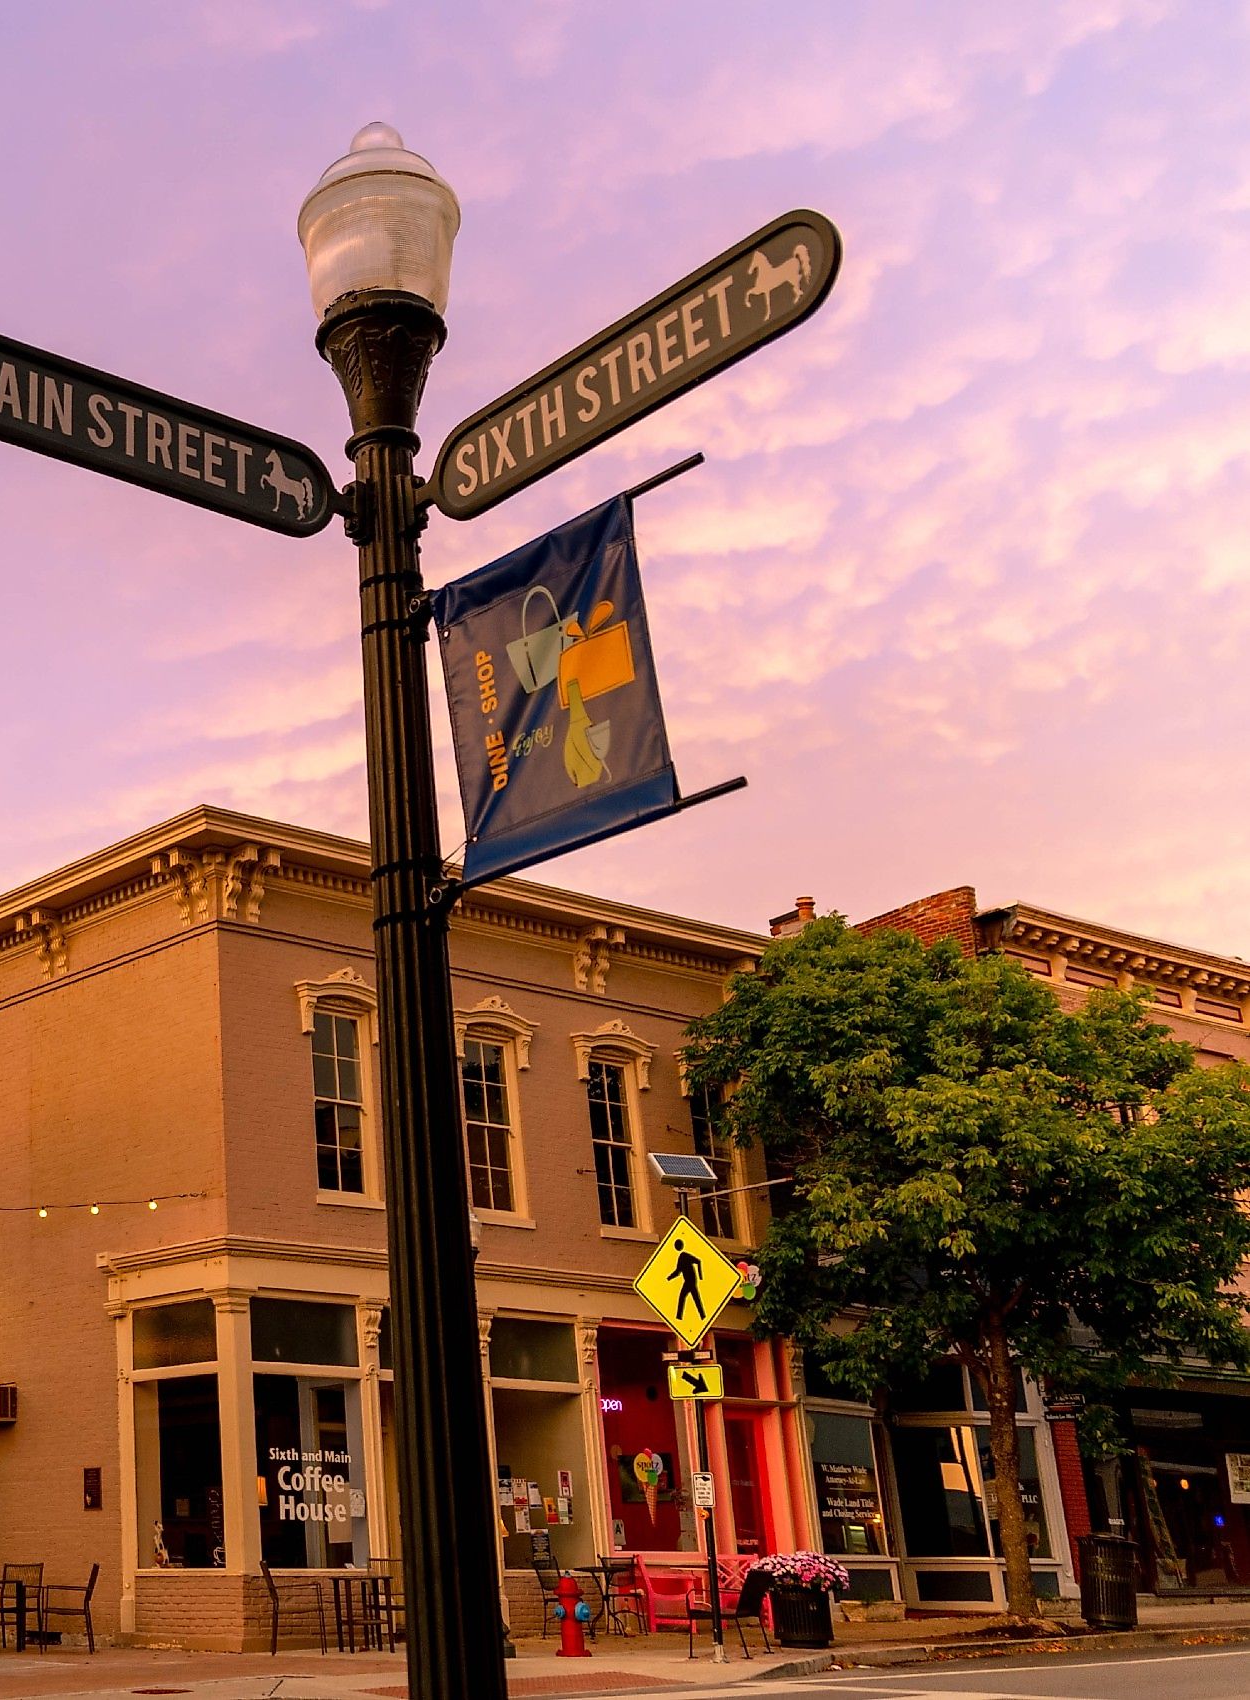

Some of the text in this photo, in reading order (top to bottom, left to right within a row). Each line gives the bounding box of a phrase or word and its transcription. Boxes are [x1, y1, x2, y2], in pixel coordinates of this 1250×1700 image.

[455, 275, 734, 497] SIXTH STREET
[87, 393, 253, 495] STREET
[474, 650, 508, 792] DINE SHOP
[269, 1447, 352, 1463] Sixth and Main
[277, 1465, 345, 1493] Coffee
[279, 1495, 347, 1522] House
[822, 1508, 833, 1518] and
[834, 1508, 855, 1520] Closing
[826, 1497, 874, 1508] Wade Land Title
